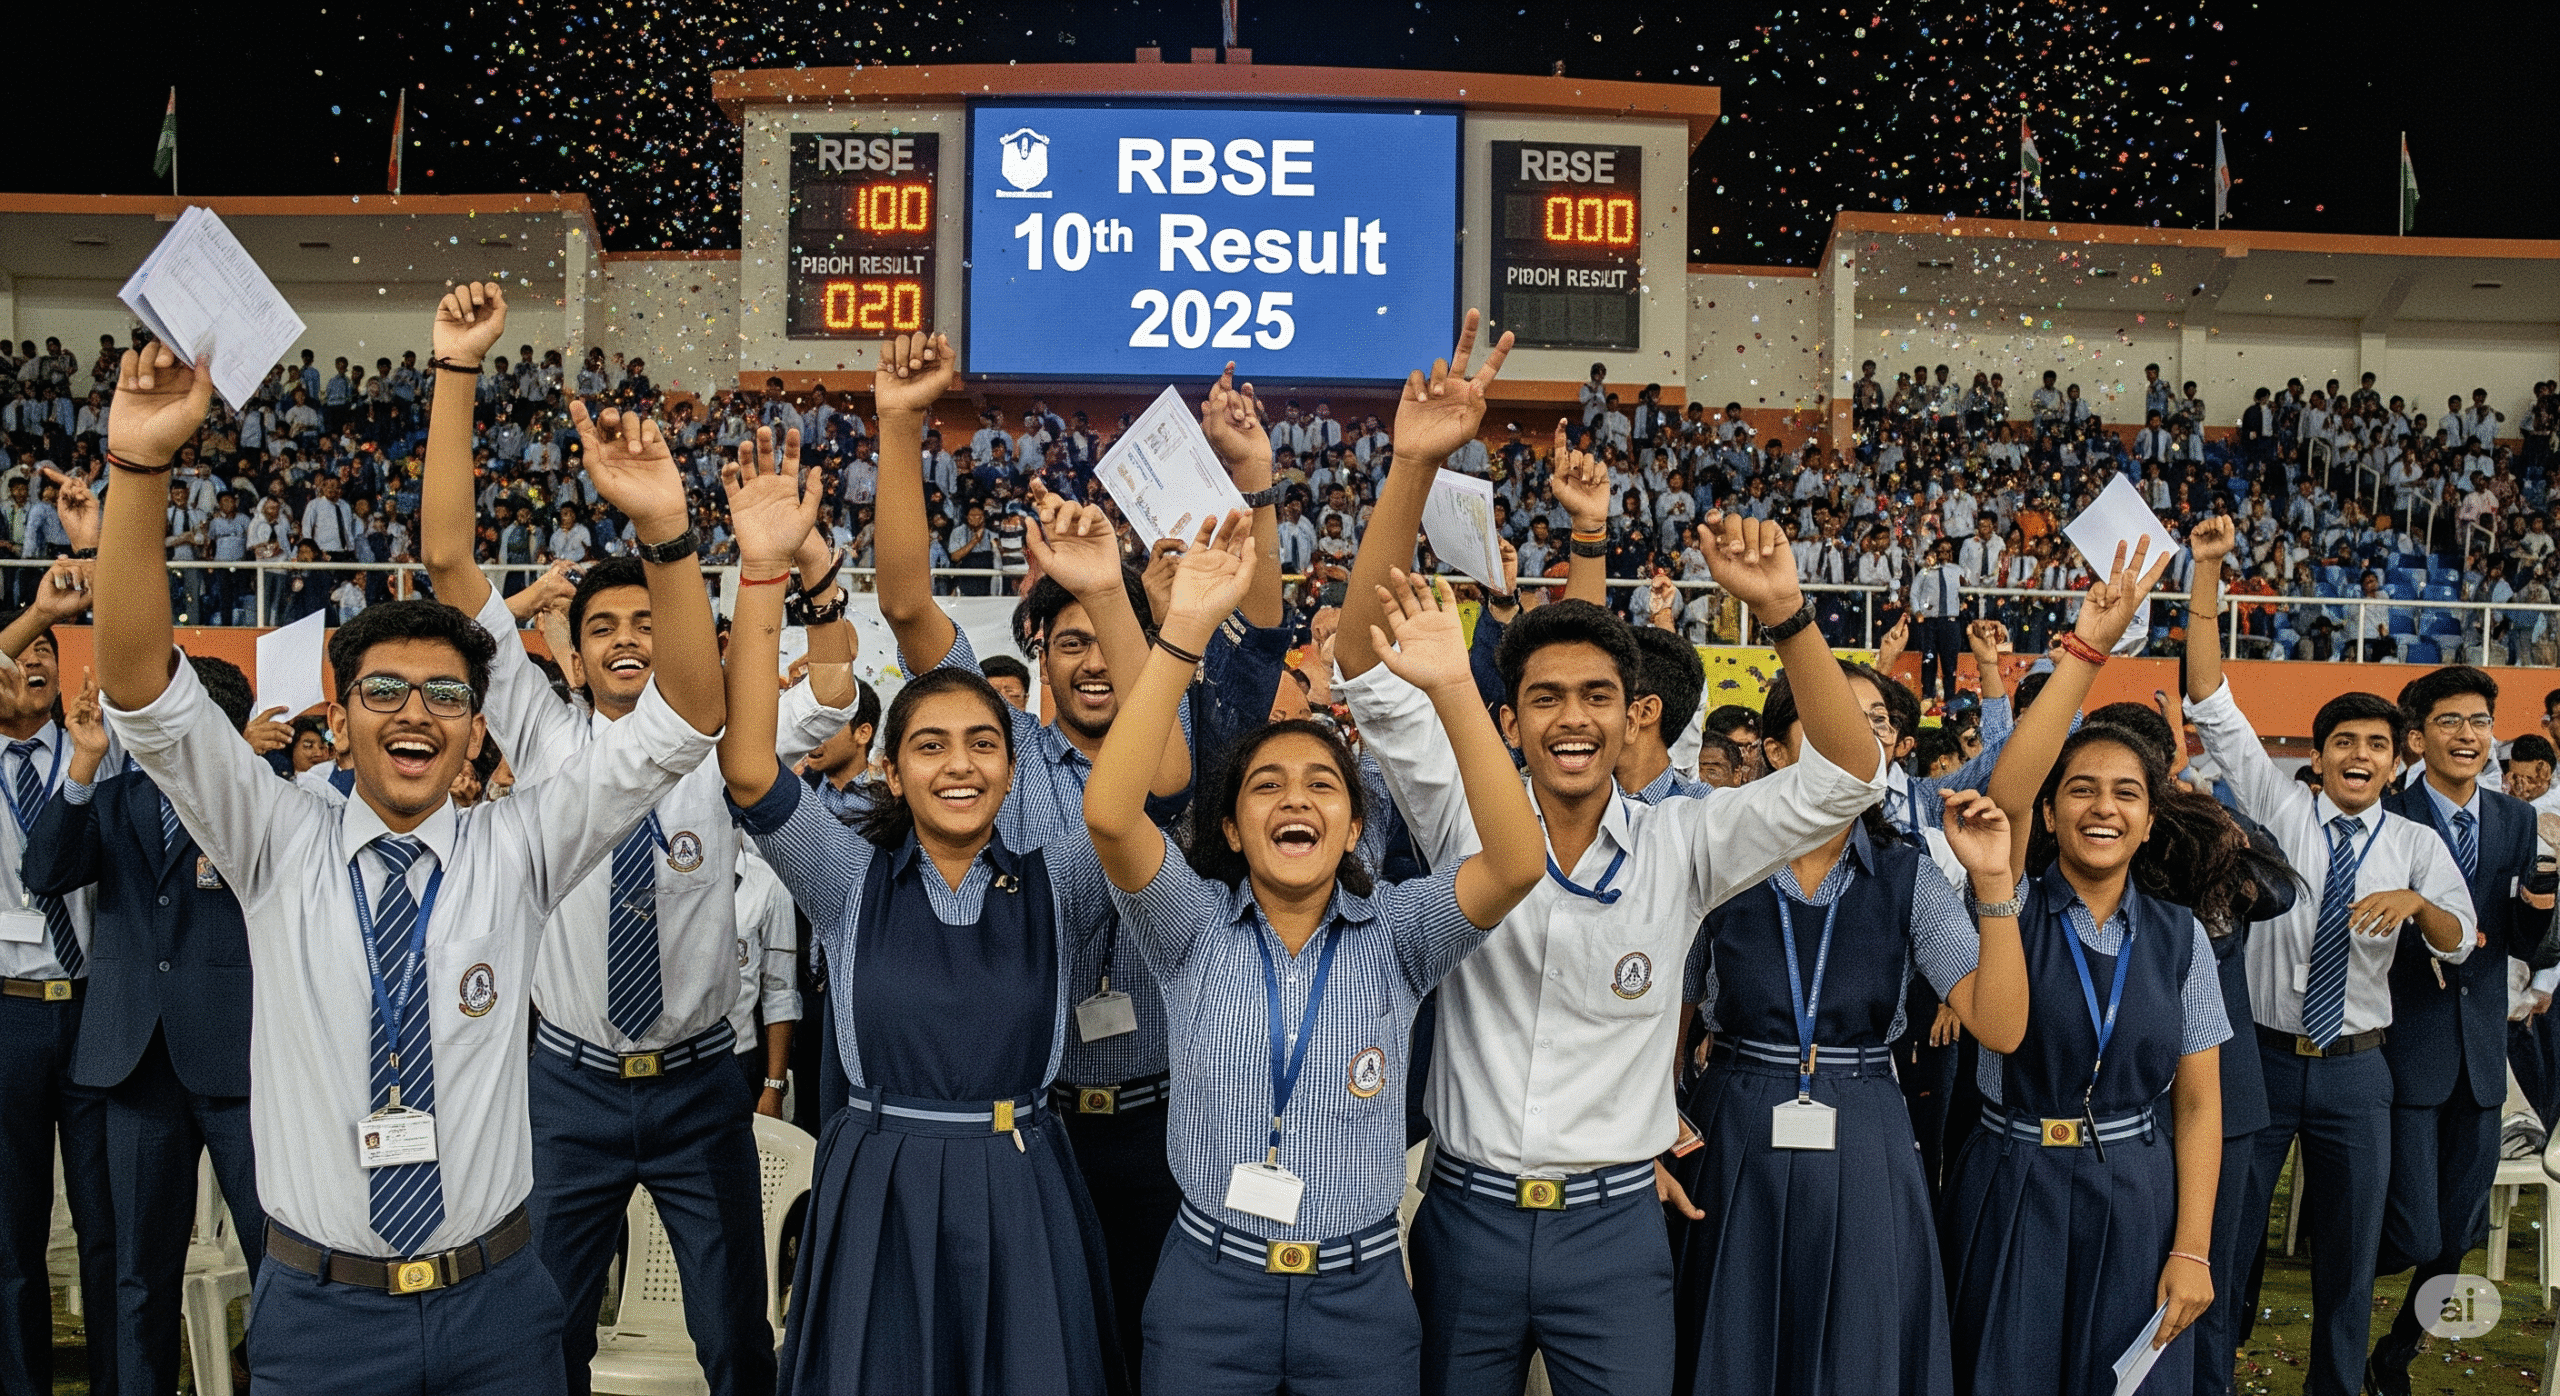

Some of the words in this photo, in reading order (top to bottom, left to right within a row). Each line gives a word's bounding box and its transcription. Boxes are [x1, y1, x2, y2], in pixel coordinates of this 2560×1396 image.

[818, 138, 914, 171] RBSE
[1118, 137, 1315, 196] RBSE
[1520, 148, 1615, 184] RBSE
[858, 185, 928, 231] 100
[1546, 196, 1634, 244] 000
[859, 256, 925, 274] RESULT
[1014, 212, 1133, 272] 10th
[1159, 213, 1387, 275] Result
[825, 282, 921, 330] 020
[1129, 289, 1296, 350] 2025
